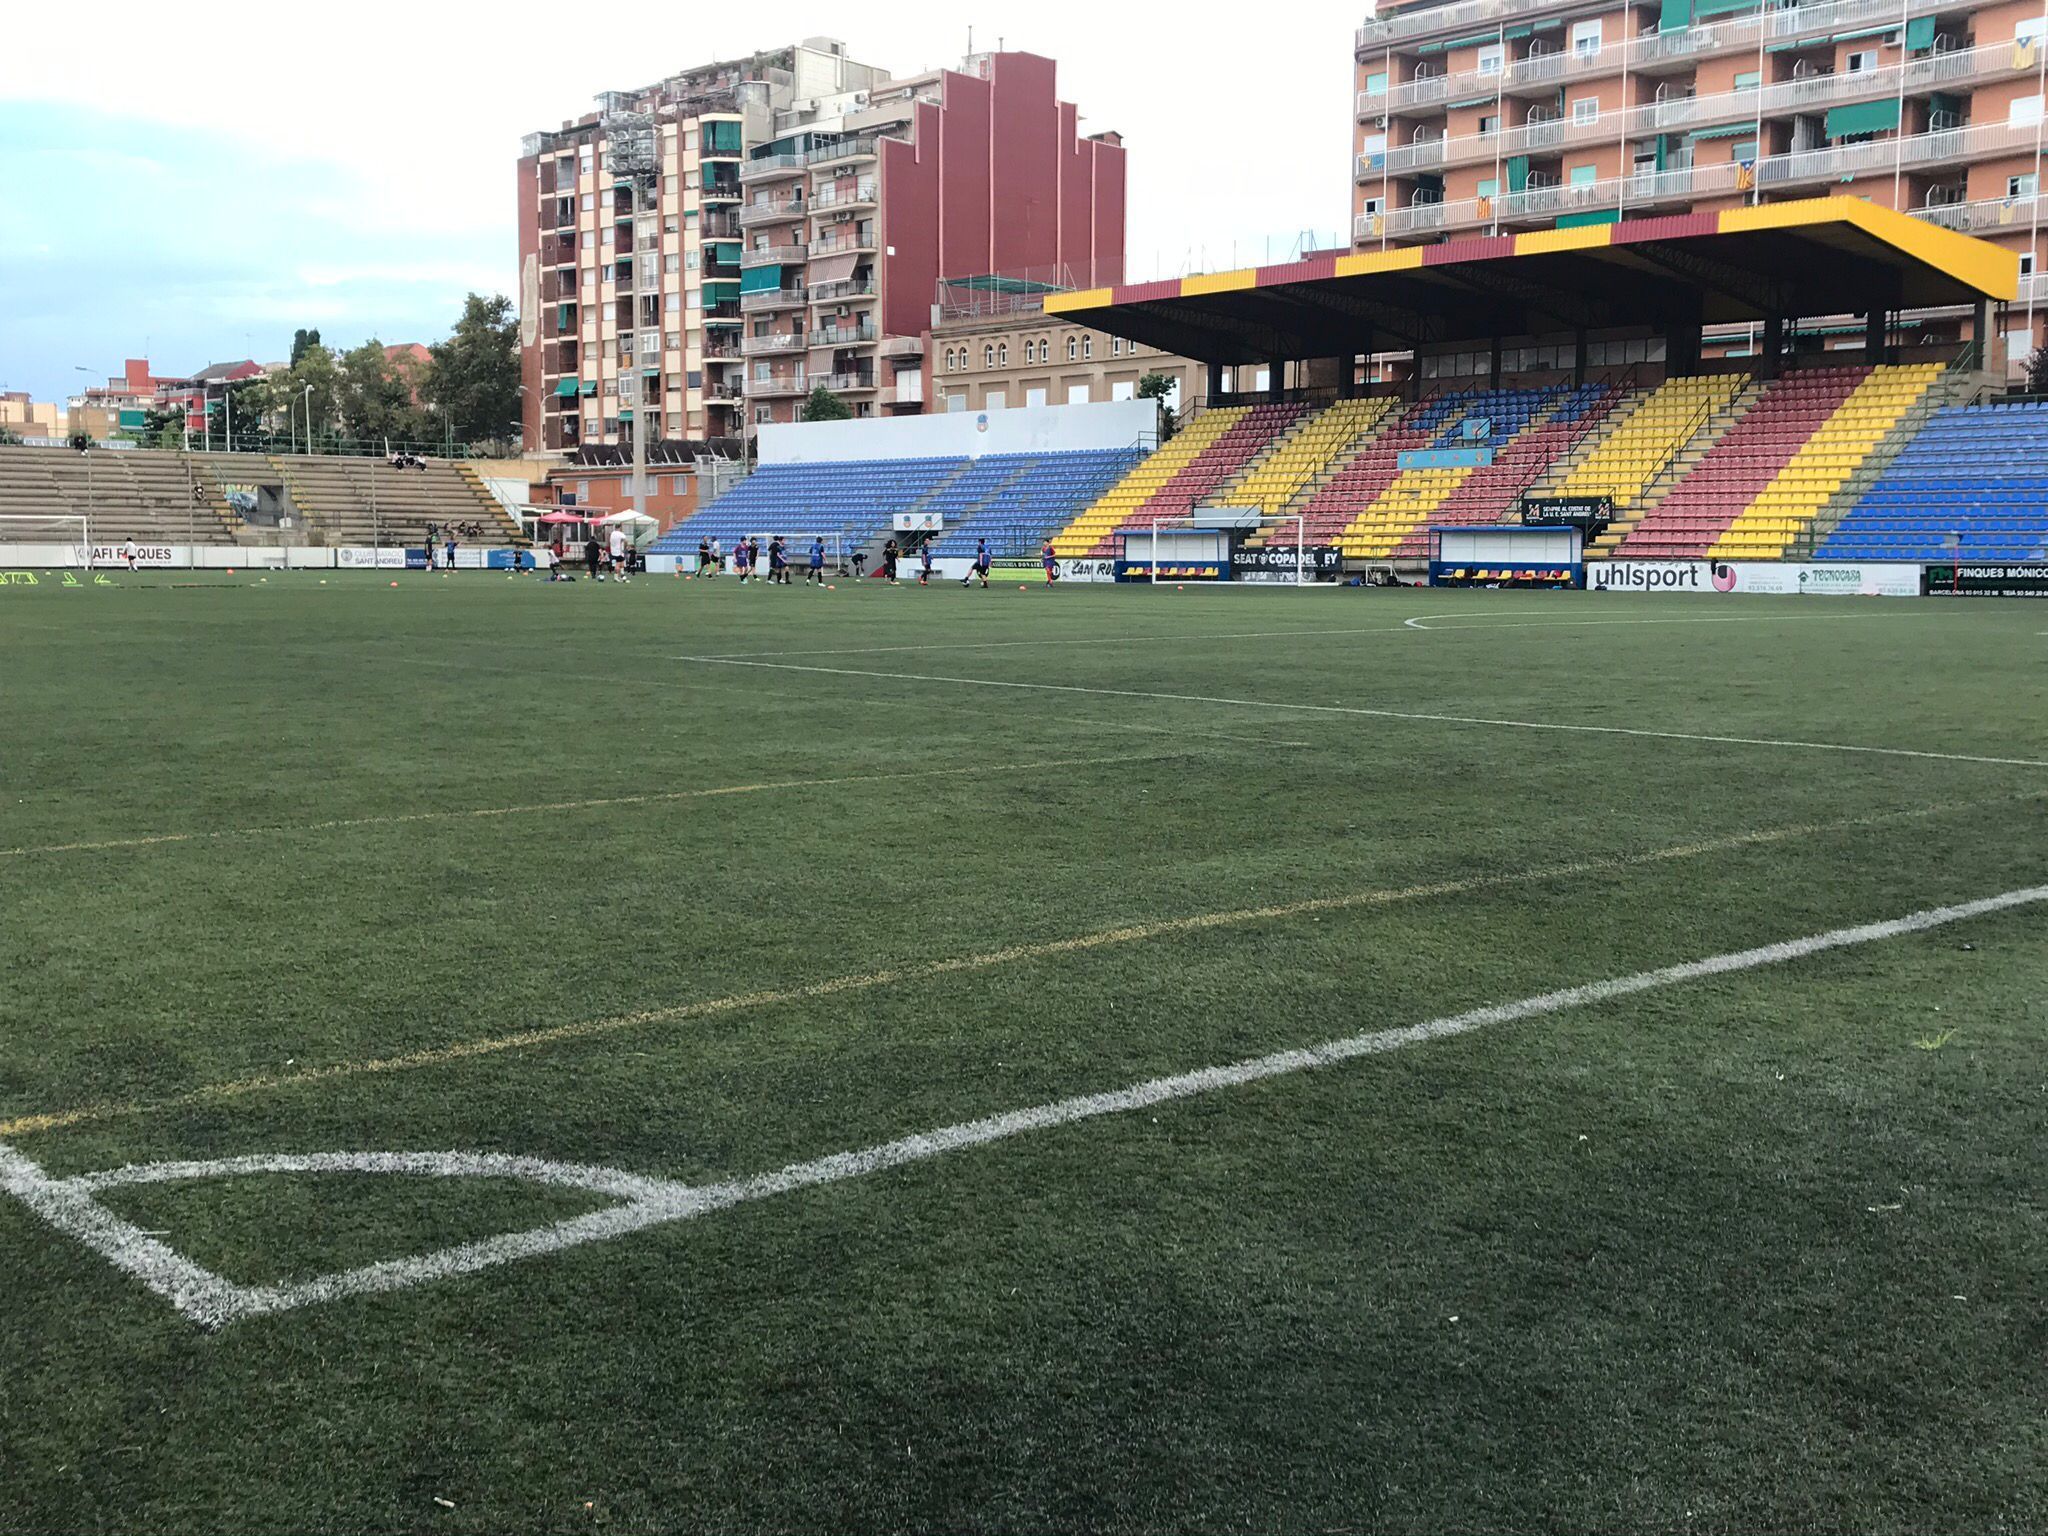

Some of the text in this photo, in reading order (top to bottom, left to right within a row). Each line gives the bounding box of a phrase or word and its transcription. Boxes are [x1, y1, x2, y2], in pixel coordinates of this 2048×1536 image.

[92, 548, 112, 559] AFI
[1233, 553, 1258, 564] SEAT
[1268, 553, 1297, 564] COPA
[1299, 553, 1317, 564] DEL
[354, 557, 374, 565] SANT
[375, 557, 404, 565] ANDREU
[1595, 563, 1699, 591] uhlsport
[1812, 569, 1861, 582] TECNOCASA
[1957, 567, 2004, 578] FINQUES
